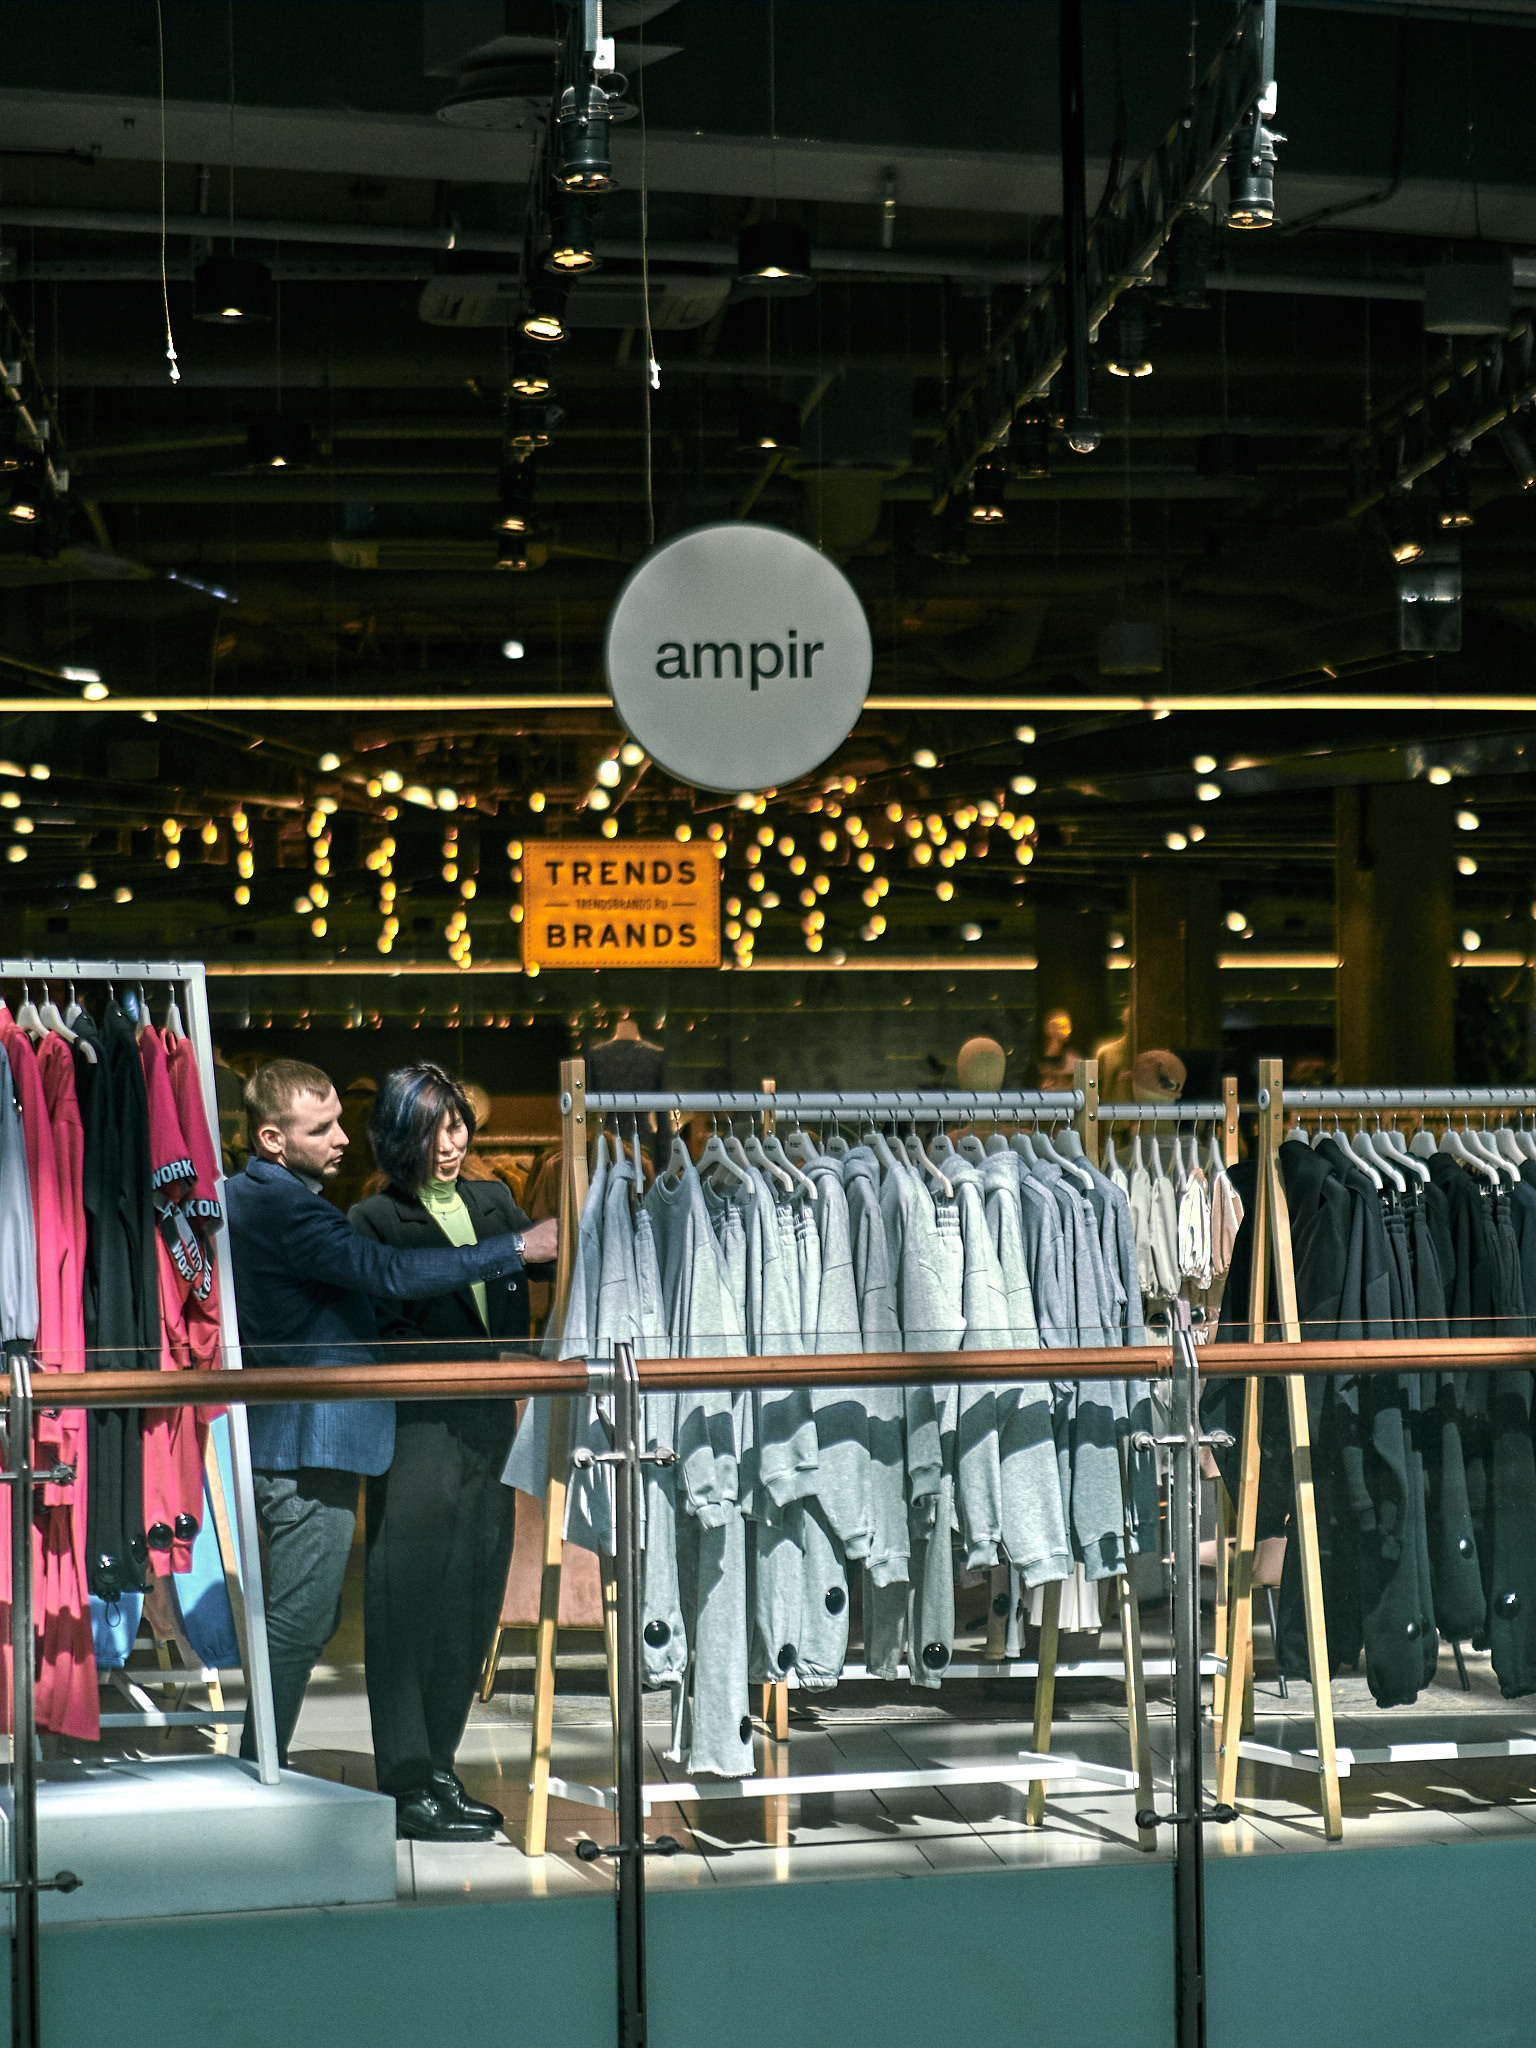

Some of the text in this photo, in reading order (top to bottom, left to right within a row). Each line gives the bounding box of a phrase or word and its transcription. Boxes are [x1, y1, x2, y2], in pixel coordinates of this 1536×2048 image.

[656, 629, 824, 691] ampir
[544, 860, 696, 886] TRENDS
[547, 923, 697, 948] BRANDS
[152, 1159, 195, 1190] WORK
